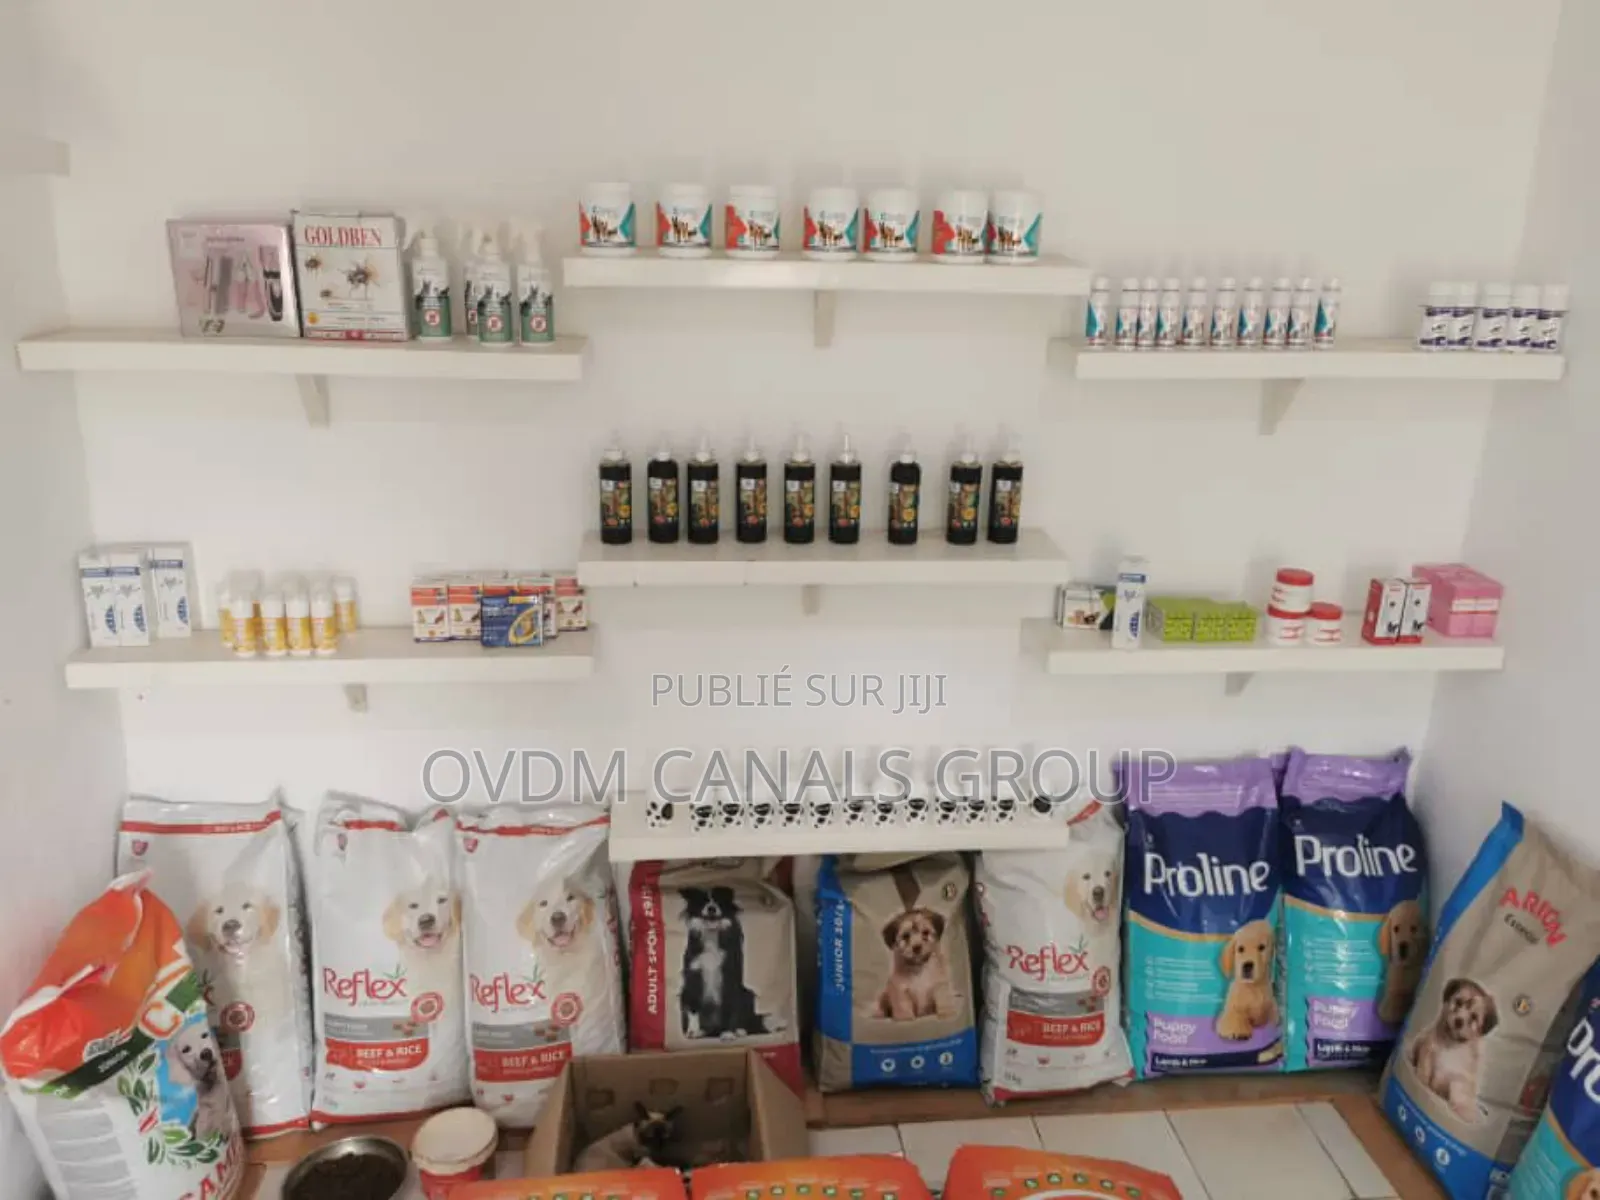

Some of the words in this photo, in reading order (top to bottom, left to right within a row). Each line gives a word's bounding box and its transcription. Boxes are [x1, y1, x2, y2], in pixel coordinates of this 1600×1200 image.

[304, 226, 382, 246] GOLDBEN
[1144, 852, 1270, 897] Proline
[1294, 834, 1418, 878] Proline
[1006, 941, 1090, 982] Reflex
[323, 966, 407, 1007] Reflex
[647, 965, 659, 1015] ADULT
[356, 1048, 383, 1059] BEEF
